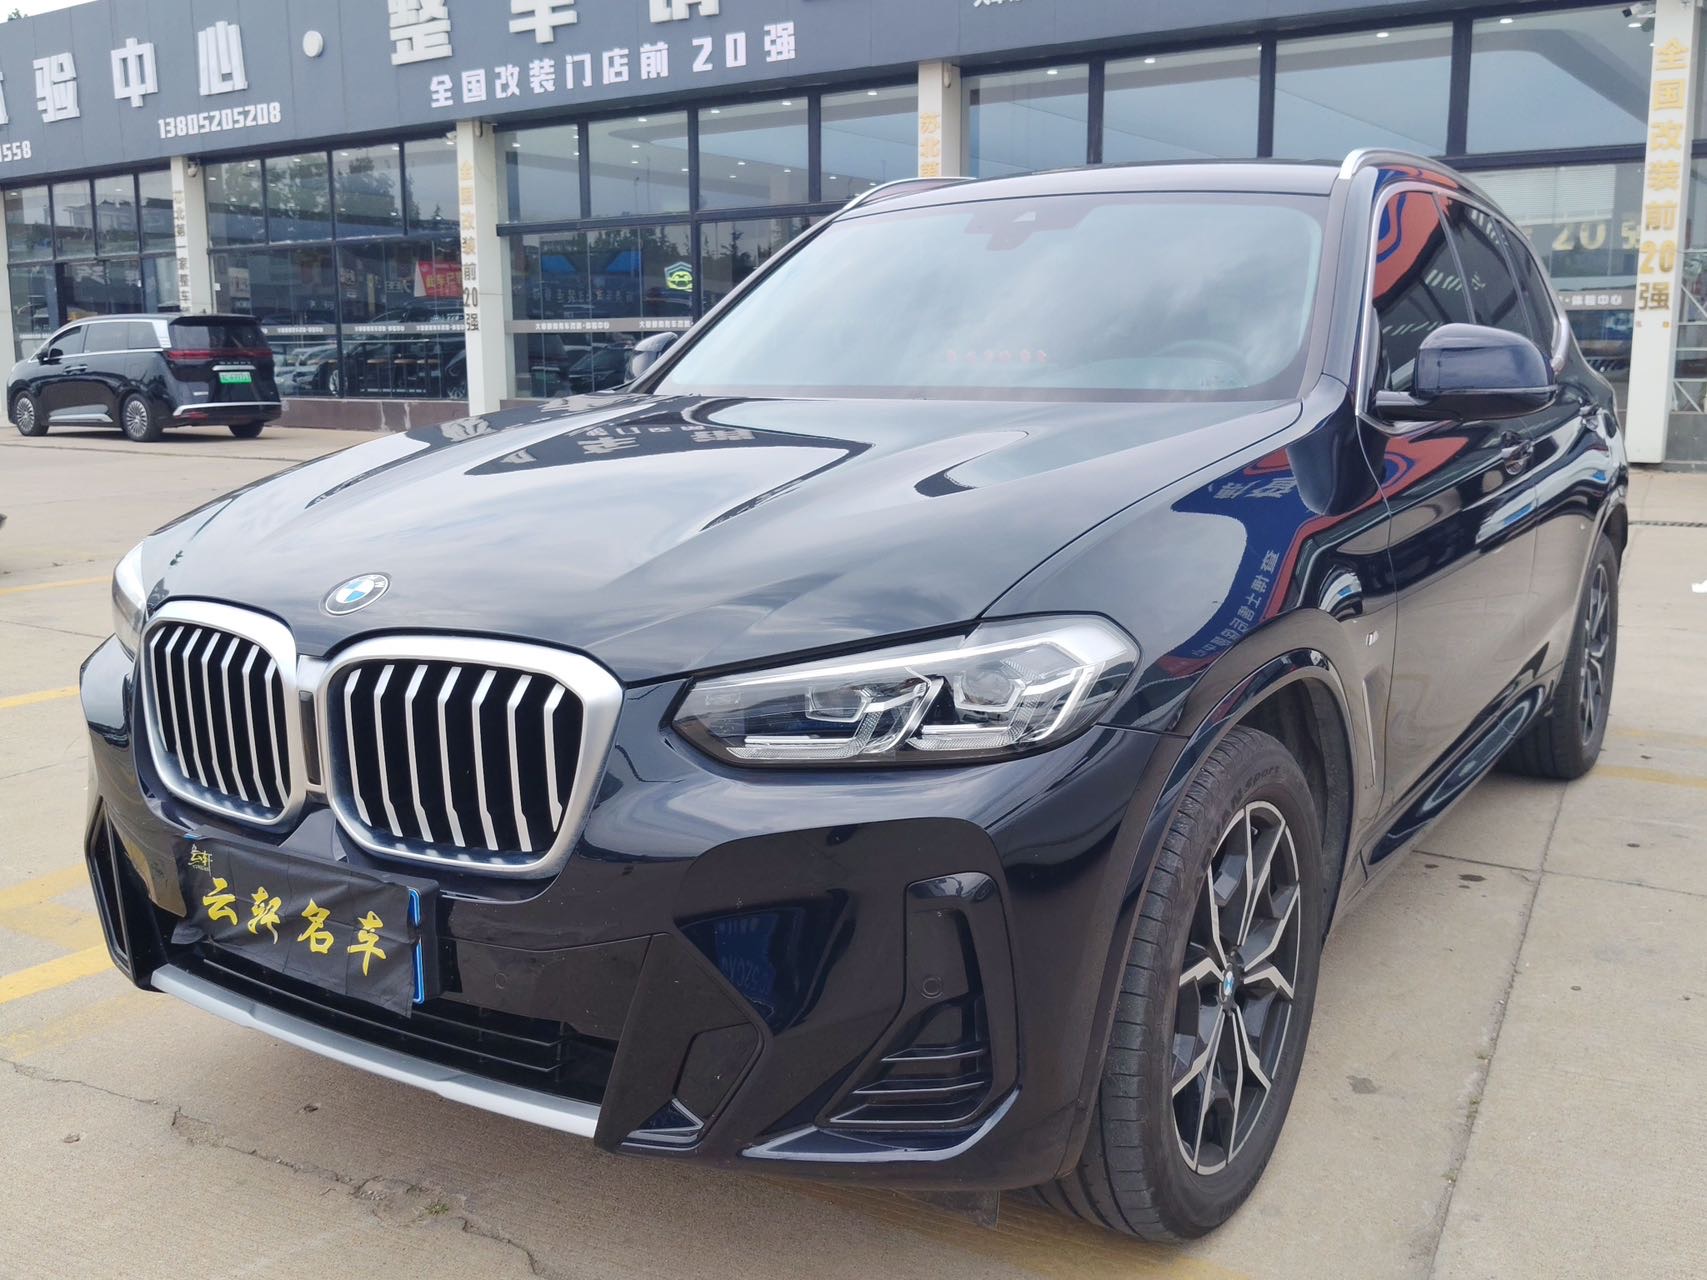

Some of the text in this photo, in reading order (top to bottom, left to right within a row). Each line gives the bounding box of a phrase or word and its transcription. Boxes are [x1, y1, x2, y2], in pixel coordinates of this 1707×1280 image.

[429, 21, 797, 109] 全国改装门店前20强
[0, 141, 32, 163] 558
[158, 102, 282, 139] 13805205208
[1638, 38, 1690, 311] 全国改装前20强
[202, 876, 387, 977] 云轩名车
